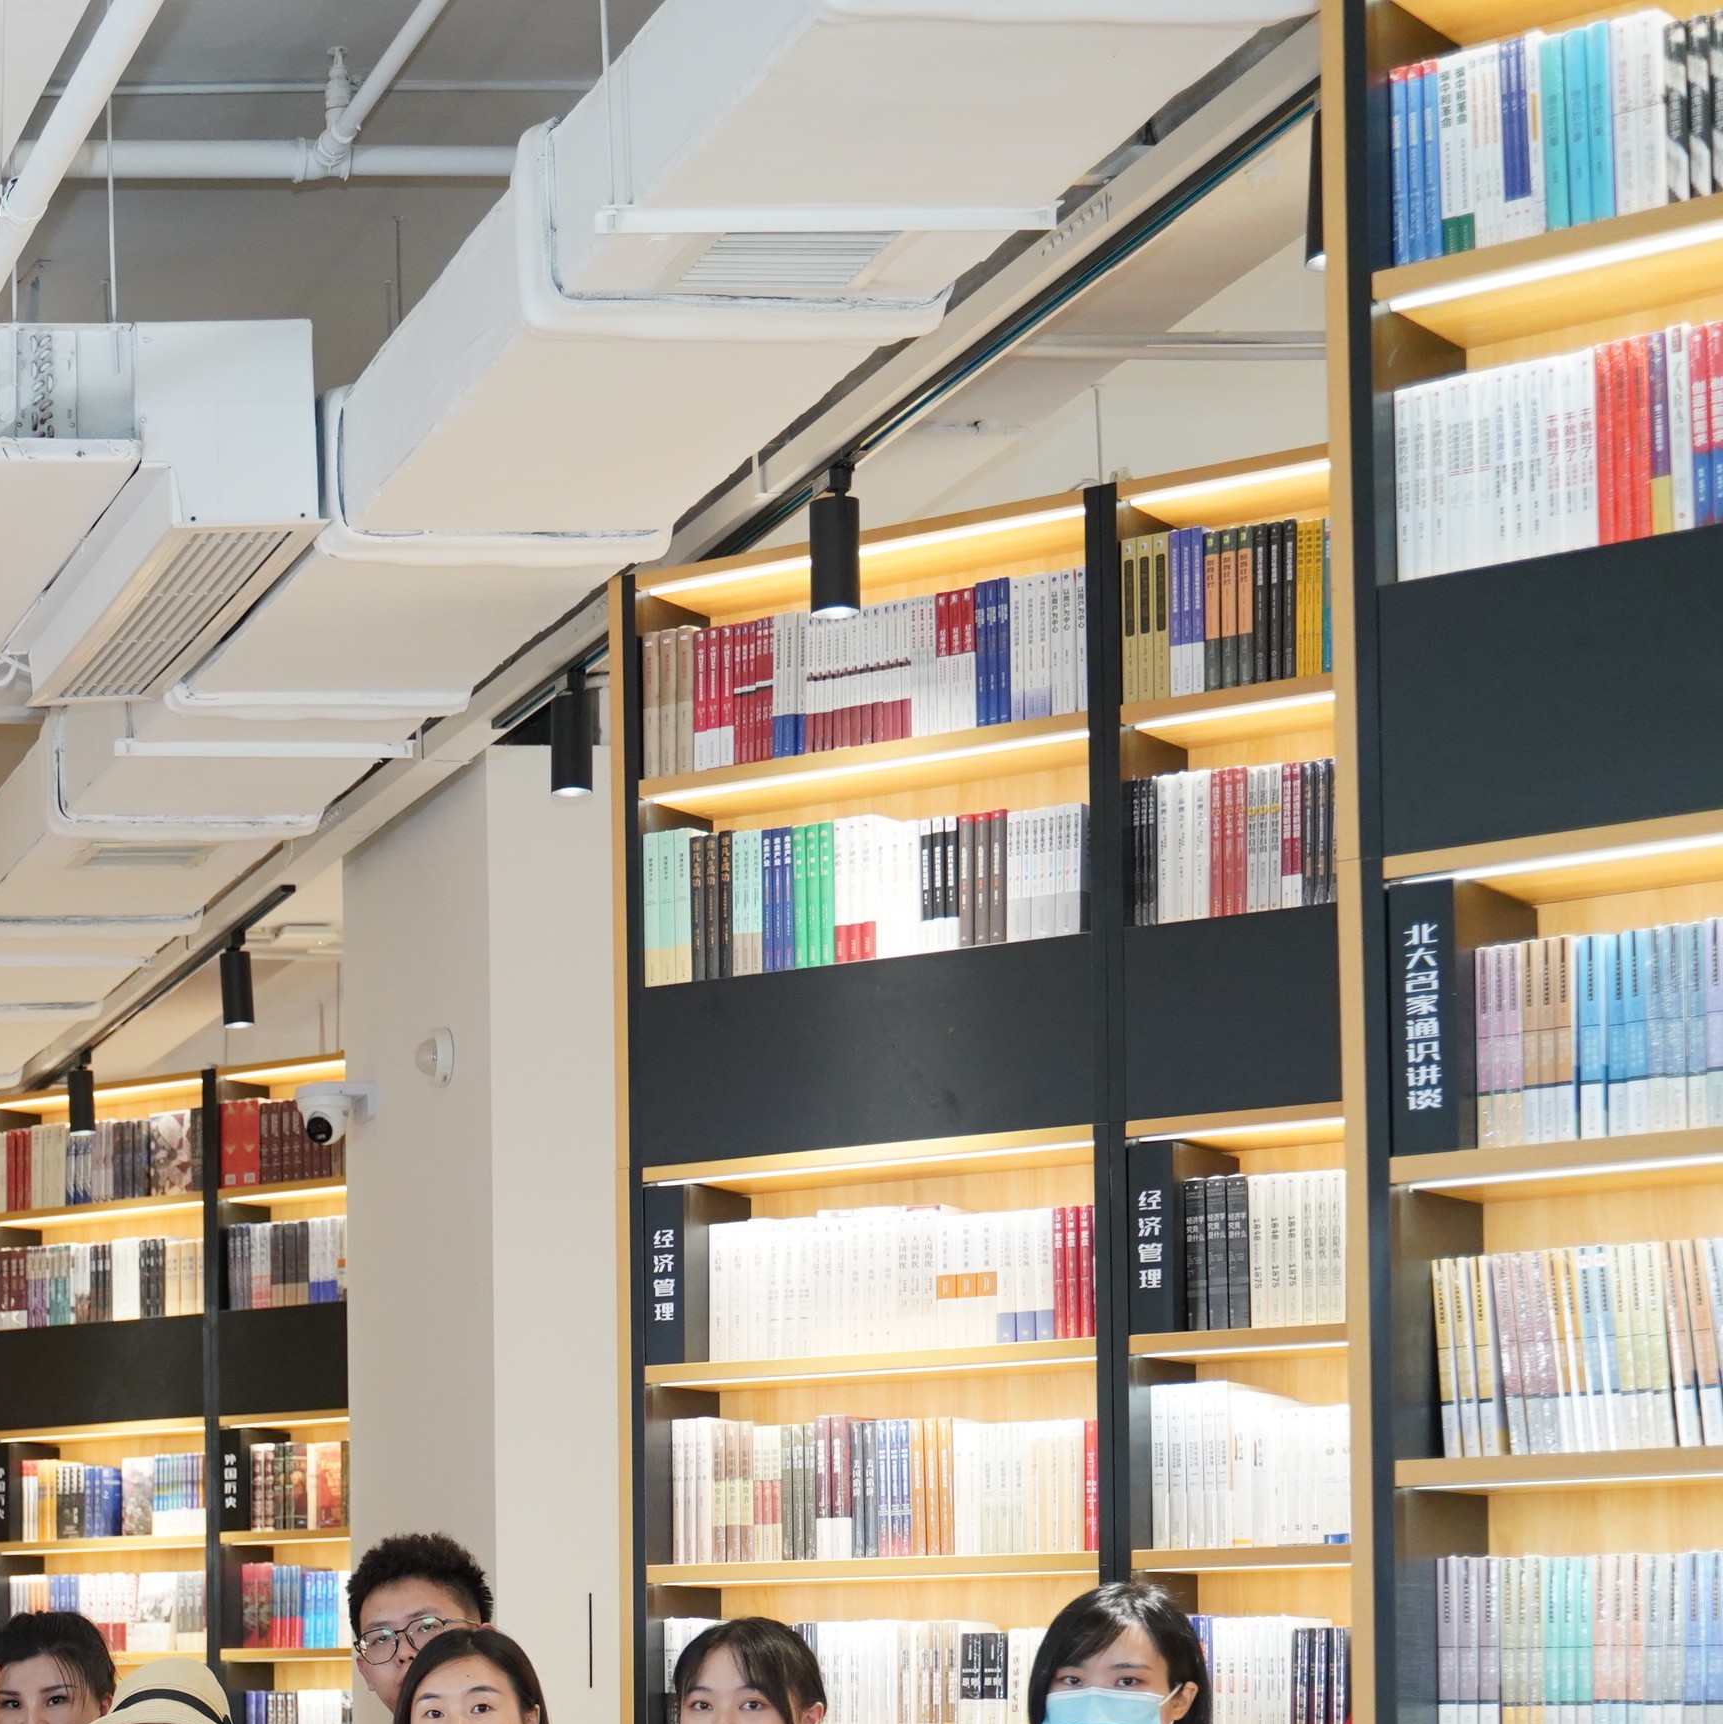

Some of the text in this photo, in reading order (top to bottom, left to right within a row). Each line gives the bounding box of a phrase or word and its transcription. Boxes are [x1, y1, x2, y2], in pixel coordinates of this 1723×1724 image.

[1403, 922, 1442, 1110] 北大名家通识讲谈
[653, 1229, 675, 1321] 经济管理
[1138, 1190, 1163, 1289] 经济管理
[1254, 1266, 1262, 1289] 1875
[224, 1453, 237, 1509] 外国历史
